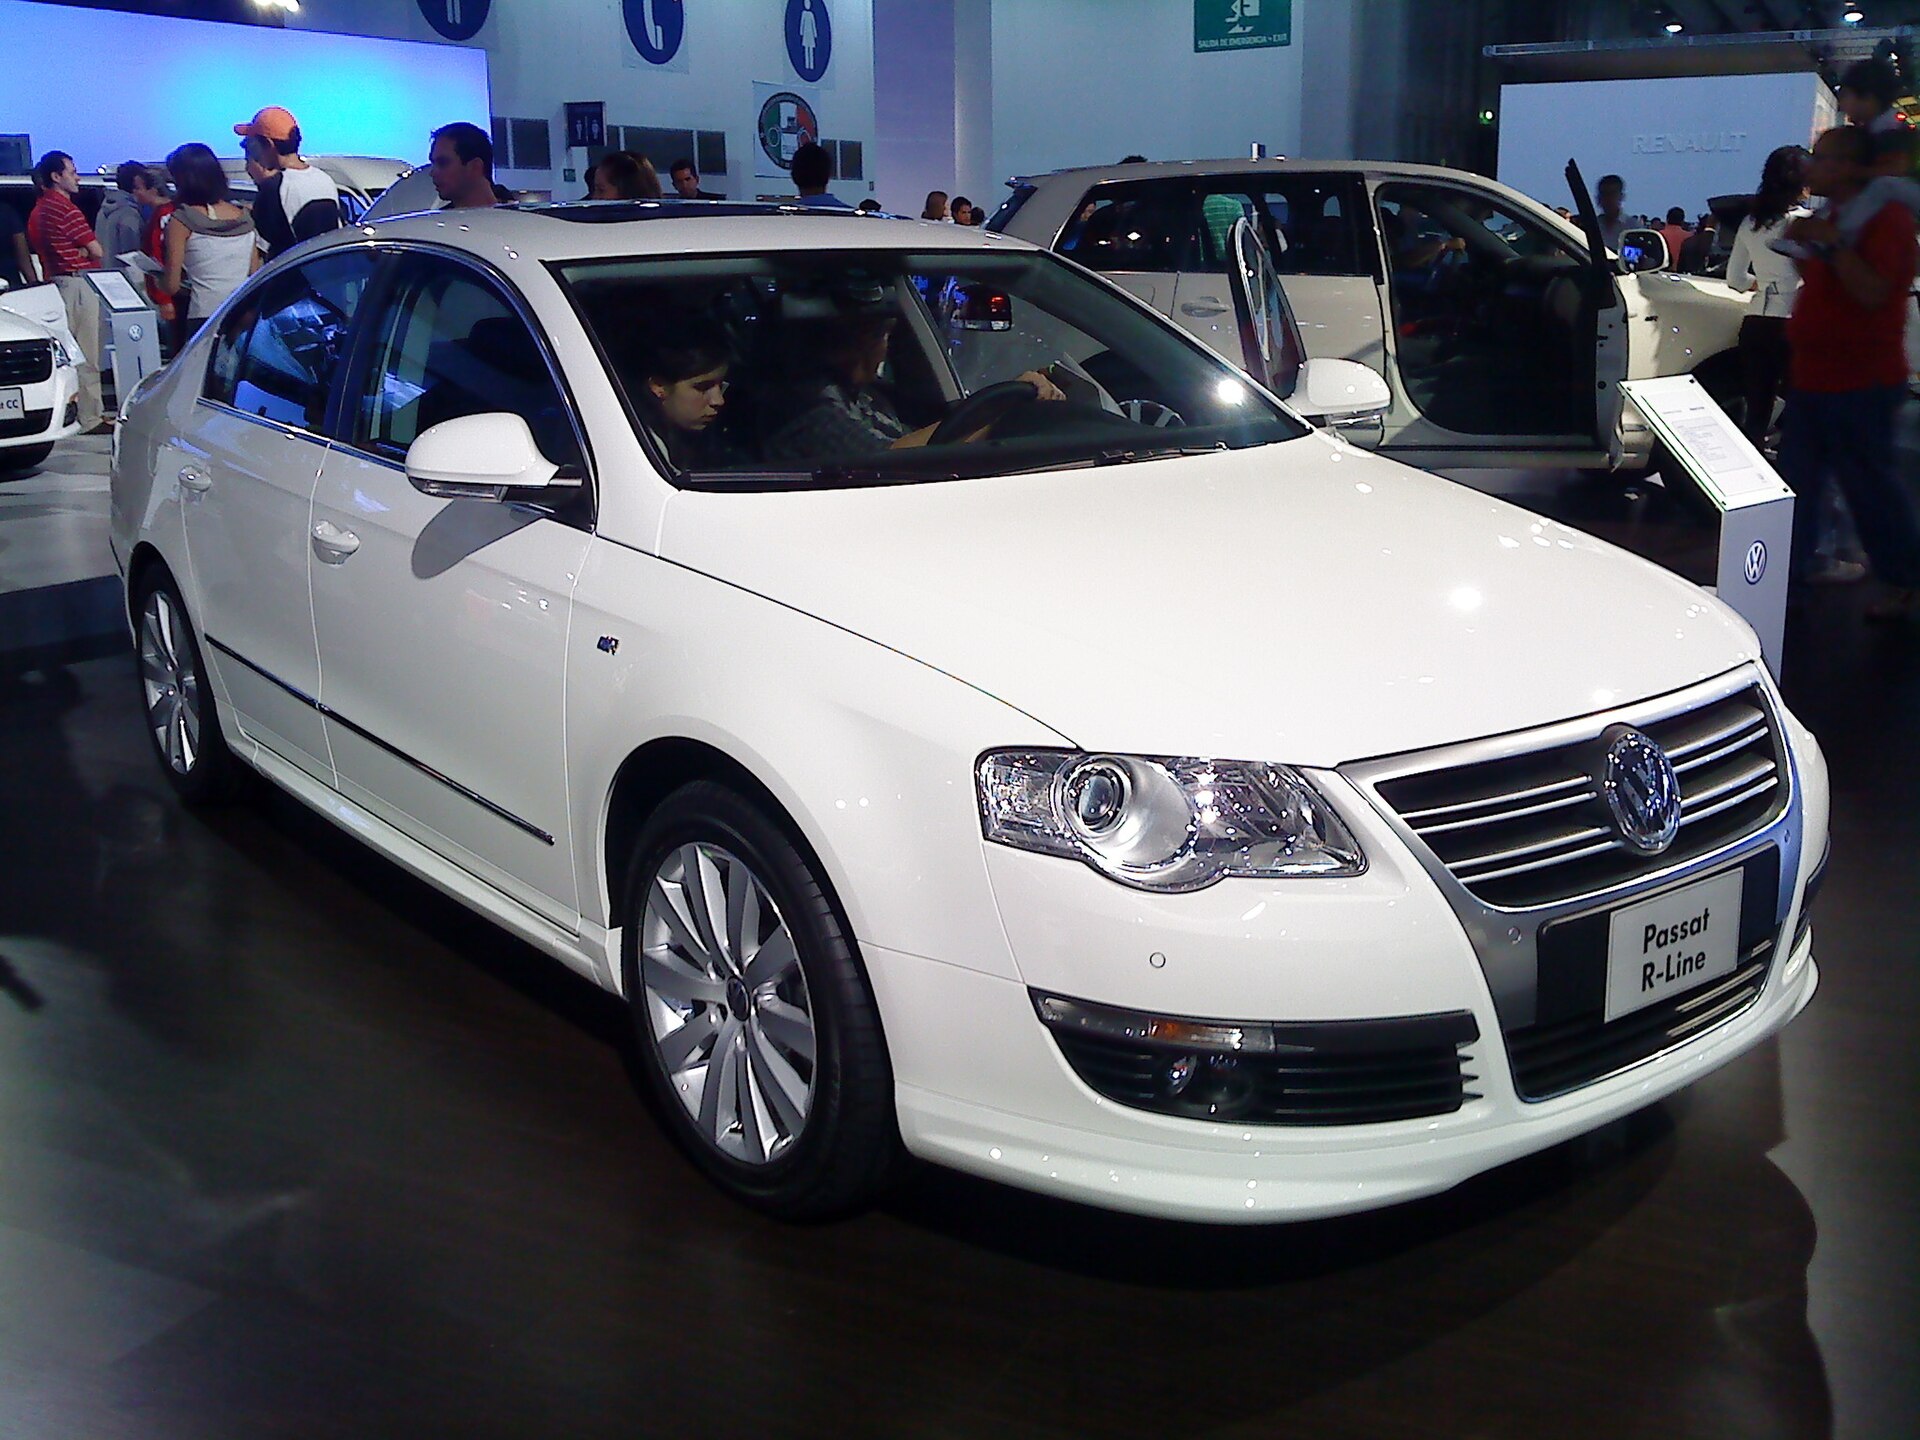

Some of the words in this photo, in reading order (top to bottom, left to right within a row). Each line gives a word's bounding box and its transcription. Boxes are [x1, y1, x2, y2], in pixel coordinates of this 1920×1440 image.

[1197, 39, 1219, 48] SALIDA
[1220, 38, 1229, 46] DE
[1229, 35, 1267, 46] EMERGENCIA
[1632, 132, 1747, 155] RENAULT
[6, 399, 18, 409] CC
[1643, 907, 1710, 954] Passat
[1641, 951, 1706, 992] R-Line
